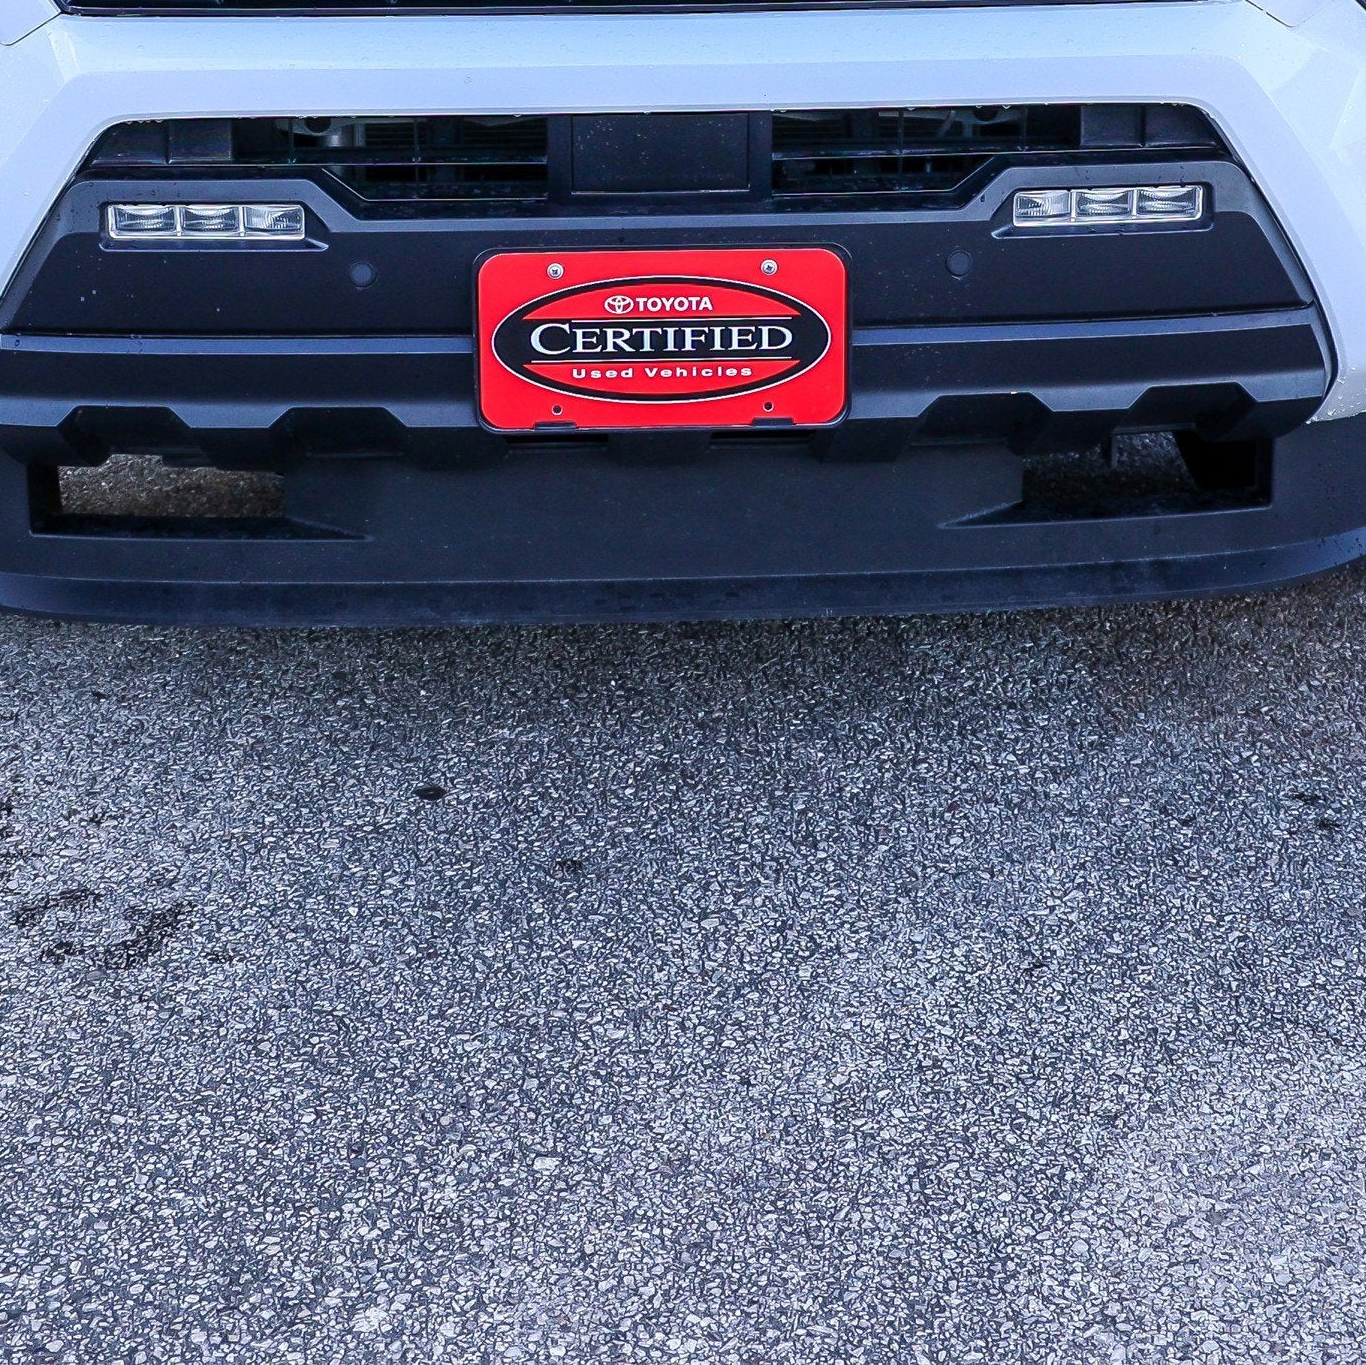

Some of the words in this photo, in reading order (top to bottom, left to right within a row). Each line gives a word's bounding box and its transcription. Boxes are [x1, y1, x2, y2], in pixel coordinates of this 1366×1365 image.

[636, 296, 714, 312] TOYOTA
[530, 323, 793, 355] CERTIFIED
[572, 367, 634, 379] Used
[644, 366, 753, 378] Vehicles
